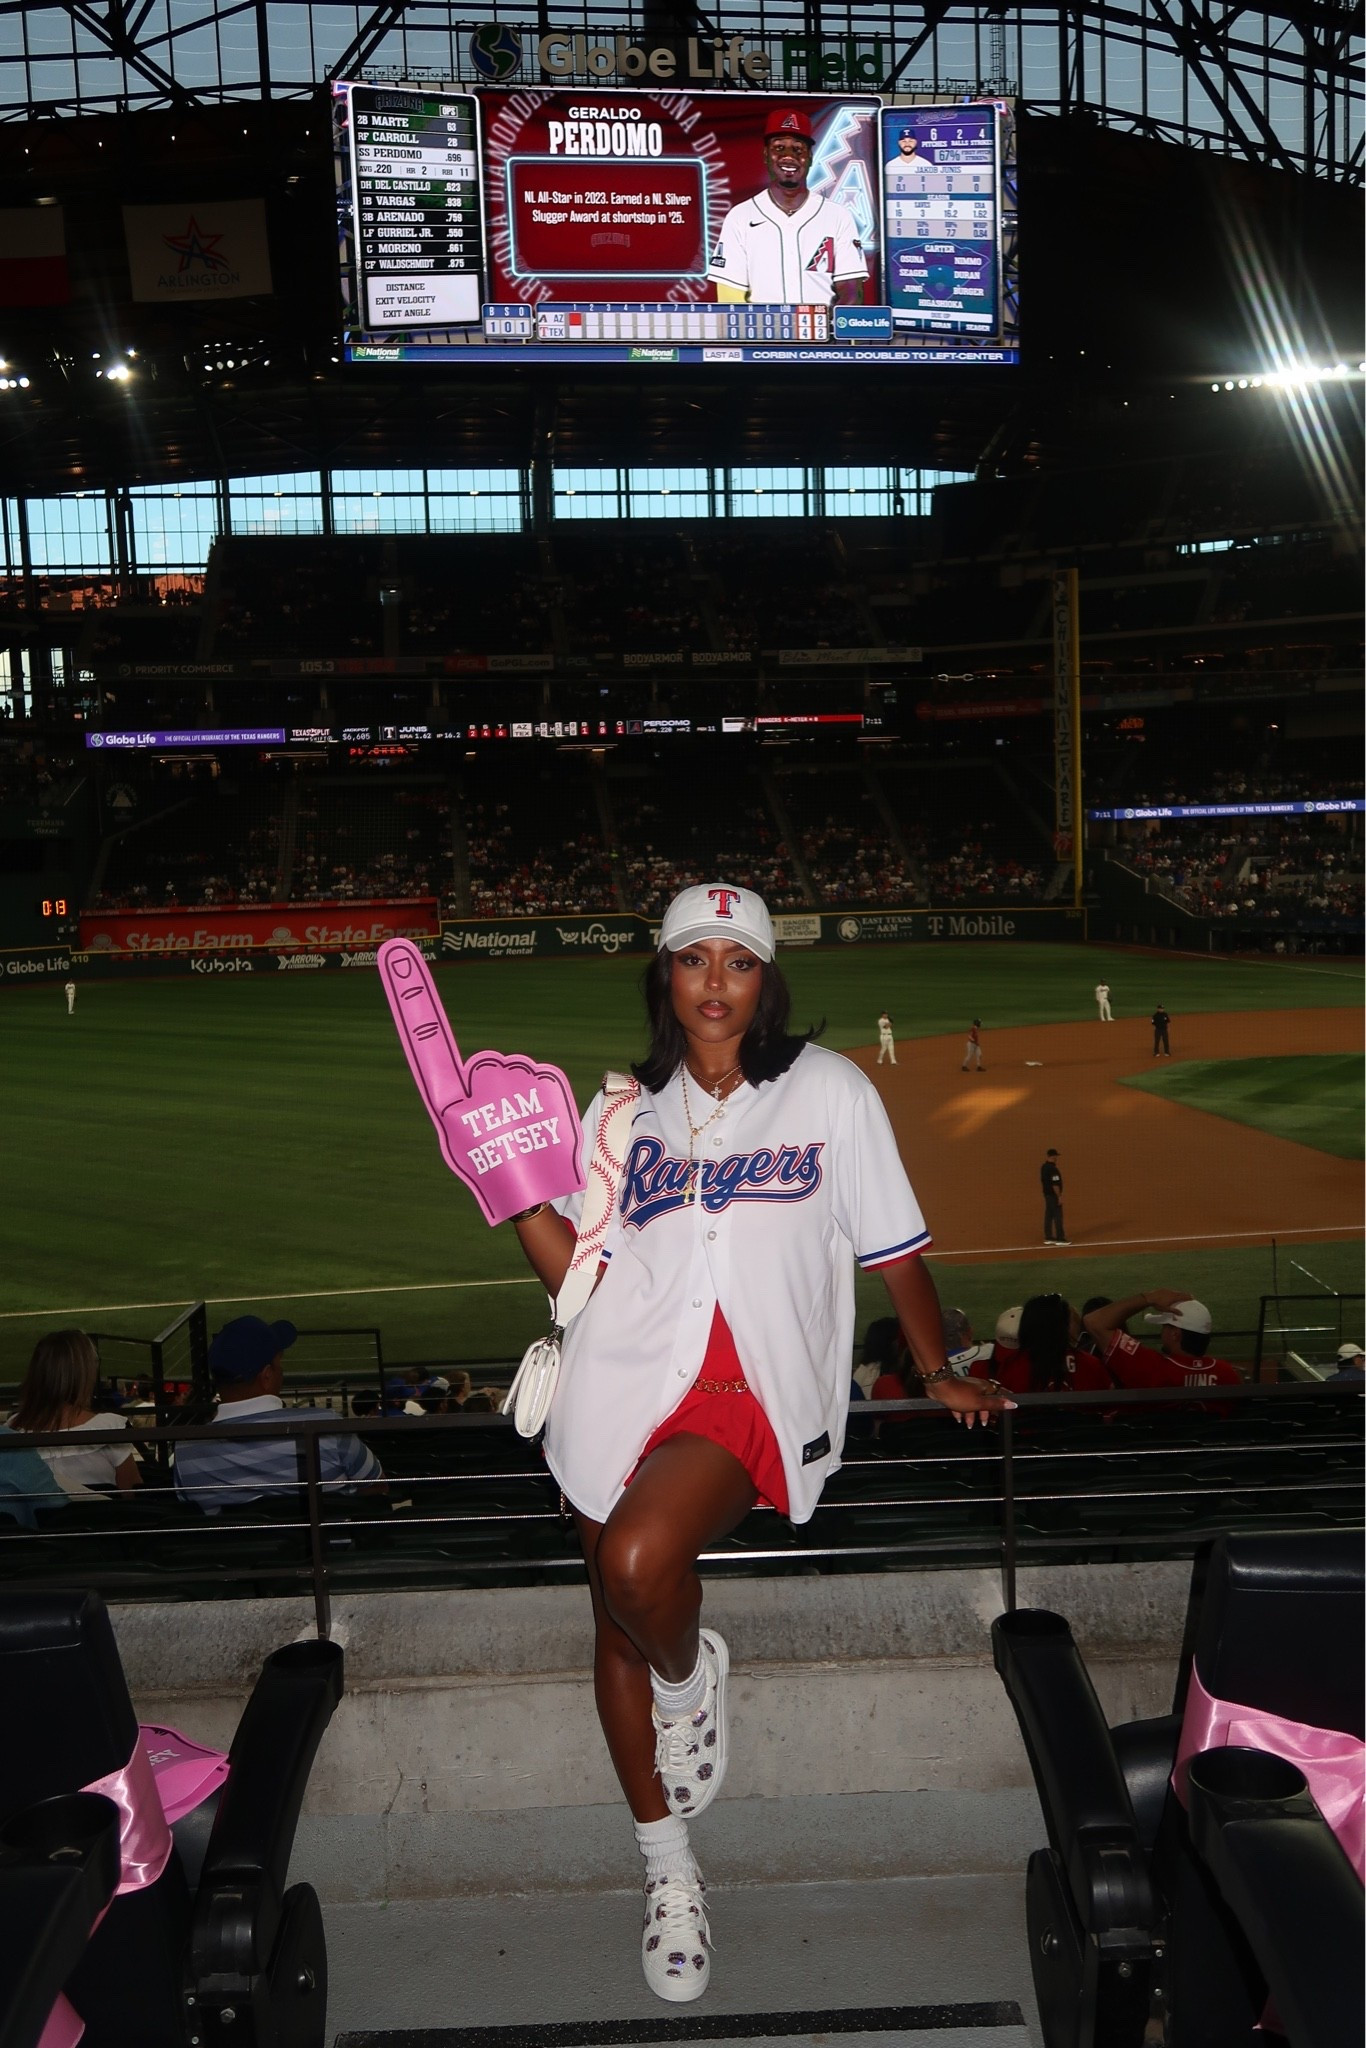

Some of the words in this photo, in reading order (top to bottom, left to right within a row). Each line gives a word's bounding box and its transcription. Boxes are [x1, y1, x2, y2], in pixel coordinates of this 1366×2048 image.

[538, 33, 677, 78] Globe
[688, 36, 771, 80] Life
[783, 36, 884, 83] Field
[375, 95, 425, 112] ARIZONA
[442, 107, 456, 116] OPS
[568, 107, 641, 120] GERALDO
[357, 115, 368, 125] 2B
[372, 116, 409, 128] MARTE
[930, 128, 937, 141] 6
[956, 129, 963, 139] 2
[979, 128, 985, 138] 4
[358, 132, 369, 141] RF
[372, 132, 420, 144] CARROLL
[447, 138, 458, 147] 2B
[548, 121, 662, 156] PERDOMO
[359, 148, 370, 157] SS
[374, 148, 422, 159] PERDOMO
[939, 150, 960, 161] 67%
[359, 165, 372, 173] AVG
[374, 164, 392, 174] .220
[421, 166, 427, 175] 2
[460, 168, 469, 177] 11
[361, 180, 372, 189] DH
[375, 180, 391, 190] DEL
[393, 181, 431, 191] CASTILLO
[362, 197, 372, 206] 1B
[375, 196, 415, 206] VARGAS
[524, 191, 536, 204] NL
[538, 191, 573, 204] All-Star
[574, 192, 583, 204] in
[584, 192, 609, 204] 2023.
[611, 192, 642, 205] Earned
[644, 196, 650, 205] a
[652, 193, 664, 205] NL
[665, 193, 692, 206] Silver
[362, 213, 374, 221] 3B
[377, 212, 425, 222] ARENADO
[532, 210, 568, 225] Slugger
[570, 210, 599, 223] Award
[601, 211, 610, 223] at
[612, 211, 656, 226] shortstop
[658, 211, 667, 223] in
[668, 212, 685, 224] '25.
[363, 229, 374, 237] LF
[377, 228, 417, 238] GURRIEL
[419, 228, 434, 238] JR.
[366, 245, 373, 253] C
[378, 244, 421, 253] MORENO
[924, 245, 955, 253] CARTER
[365, 261, 376, 269] CF
[379, 259, 435, 269] WALDSCHMIDT
[157, 272, 240, 287] ARLINGTON
[386, 283, 425, 291] DISTANCE
[375, 297, 395, 305] EXIT
[397, 296, 436, 304] VELOCITY
[383, 310, 402, 318] EXIT
[404, 309, 431, 317] ANGLE
[489, 307, 495, 316] B
[504, 307, 510, 316] S
[780, 305, 791, 313] LOB
[553, 314, 564, 323] AZ
[848, 318, 873, 327] Globe
[874, 318, 890, 327] Life
[490, 321, 496, 332] 1
[519, 321, 525, 333] 1
[550, 328, 563, 337] TEX
[365, 347, 400, 356] National
[641, 348, 673, 357] National
[800, 352, 853, 360] CARROLL
[855, 352, 909, 360] DOUBLED
[912, 352, 927, 360] TO
[929, 352, 1004, 361] LEFT-CENTER
[623, 653, 684, 663] BODYARMOR
[692, 651, 752, 662] BODYARMOR
[299, 661, 335, 672] 105.3
[490, 658, 550, 669] GoPGL.com
[135, 664, 179, 674] PRIORITY
[181, 664, 234, 674] COMMERCE
[106, 735, 135, 745] Globe
[137, 734, 157, 744] Life
[1316, 801, 1340, 811] Globe
[1341, 801, 1357, 810] Life
[1135, 809, 1157, 817] Globe
[1158, 808, 1172, 817] Life
[707, 889, 741, 919] T
[782, 918, 816, 926] RANGERS
[862, 916, 884, 925] EAST
[888, 916, 913, 925] TEXAS
[876, 924, 899, 933] A&M
[928, 916, 944, 936] T
[950, 915, 1016, 937] Mobile
[423, 939, 434, 947] 374
[464, 930, 535, 948] National
[580, 923, 635, 953] Kroger
[489, 948, 504, 956] Car
[506, 947, 533, 956] Rental
[71, 955, 89, 963] 410
[290, 954, 319, 963] ARROW
[6, 960, 45, 975] Globe
[46, 957, 70, 972] Life
[191, 957, 252, 973] Kubota
[461, 1087, 544, 1138] TEAM
[466, 1116, 561, 1176] BETSEY
[619, 1135, 826, 1231] Rangers
